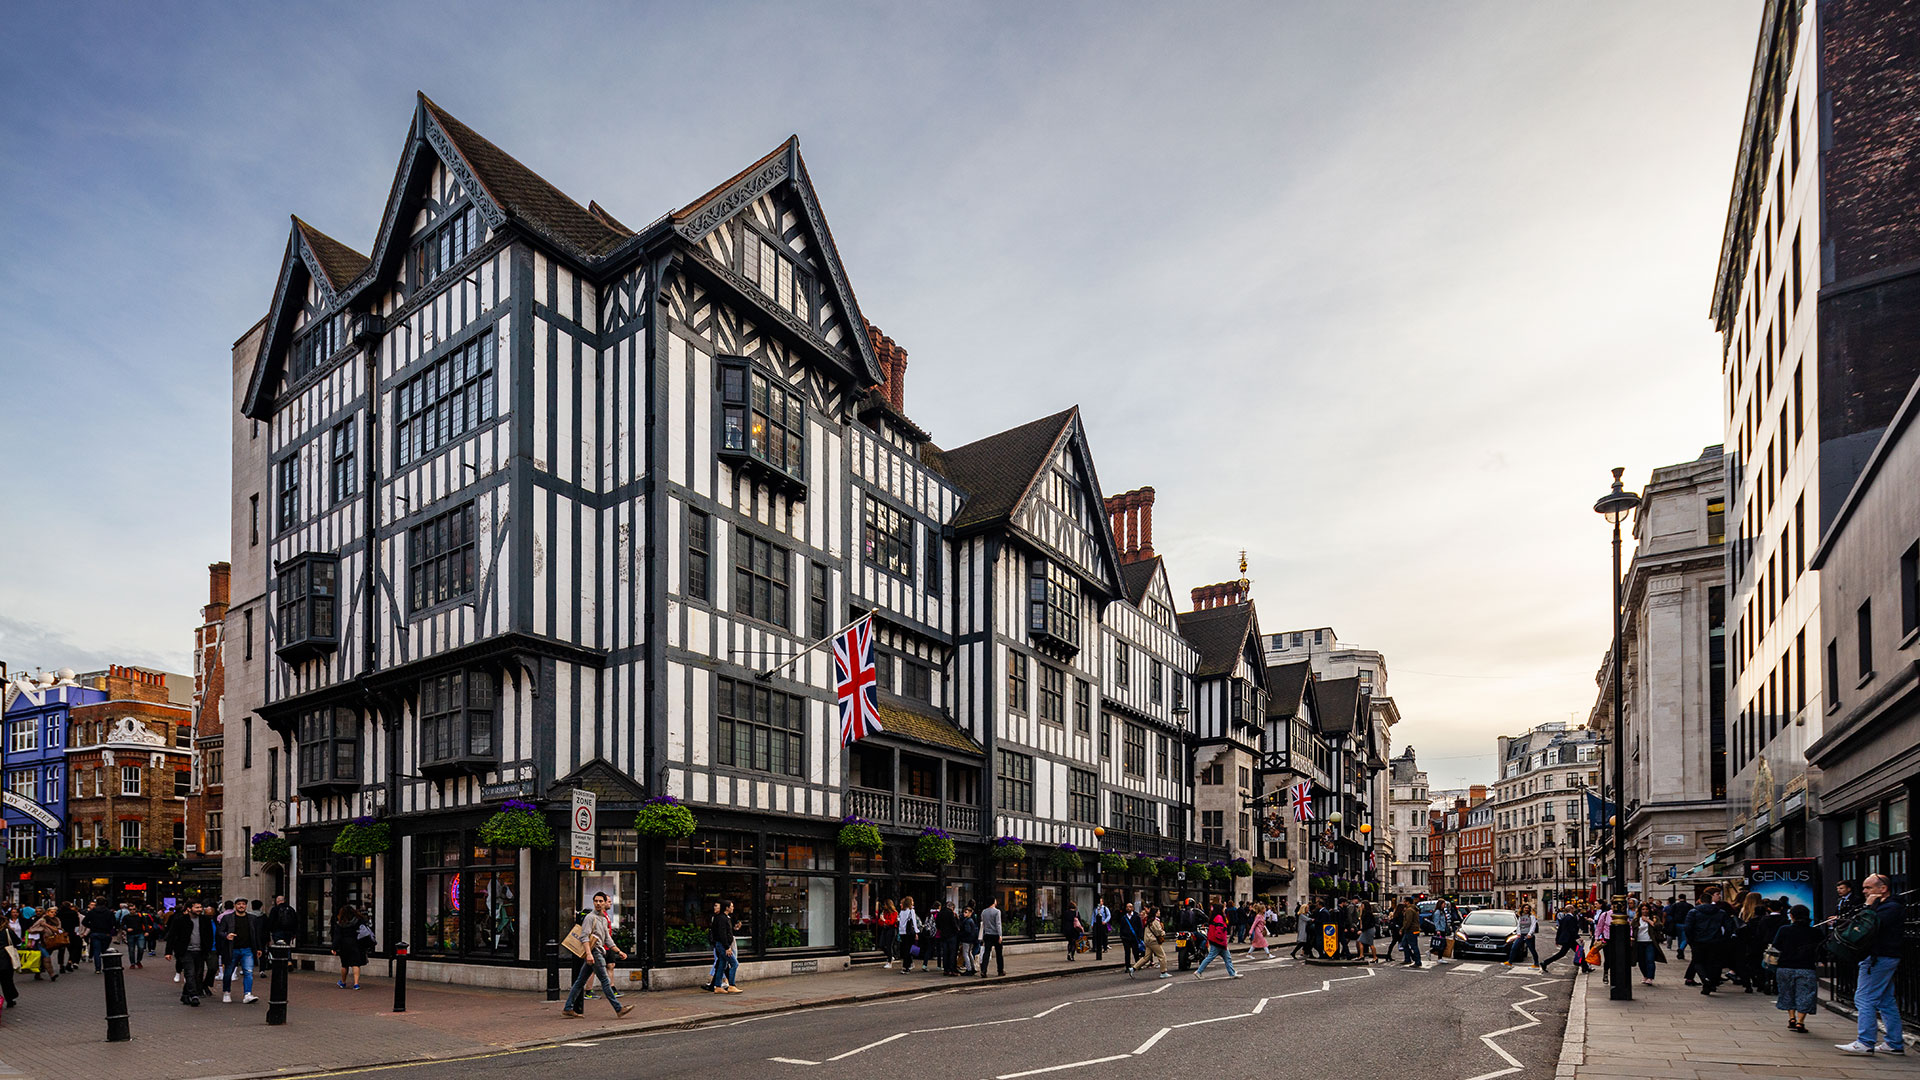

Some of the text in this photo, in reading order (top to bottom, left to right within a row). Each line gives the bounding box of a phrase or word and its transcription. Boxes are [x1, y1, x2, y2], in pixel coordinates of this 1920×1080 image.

[576, 797, 592, 807] ZONE
[22, 803, 54, 823] STREET
[1752, 870, 1810, 882] GENIUS
